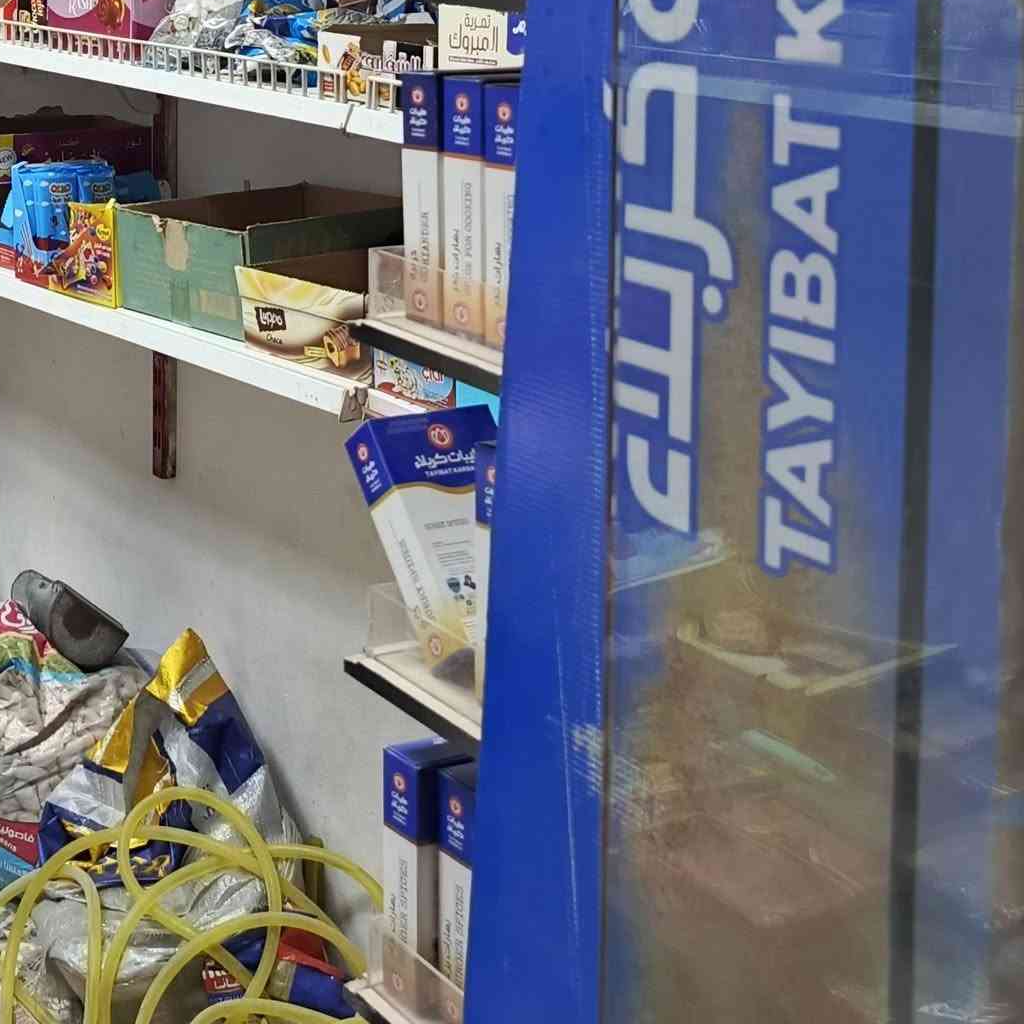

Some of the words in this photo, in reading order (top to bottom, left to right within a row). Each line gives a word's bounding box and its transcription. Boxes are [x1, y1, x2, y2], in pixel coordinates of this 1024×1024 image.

[449, 24, 499, 56] المبروك
[464, 12, 491, 30] تمرية
[611, 62, 735, 533] كربلاء
[762, 94, 843, 571] TAYIBAT
